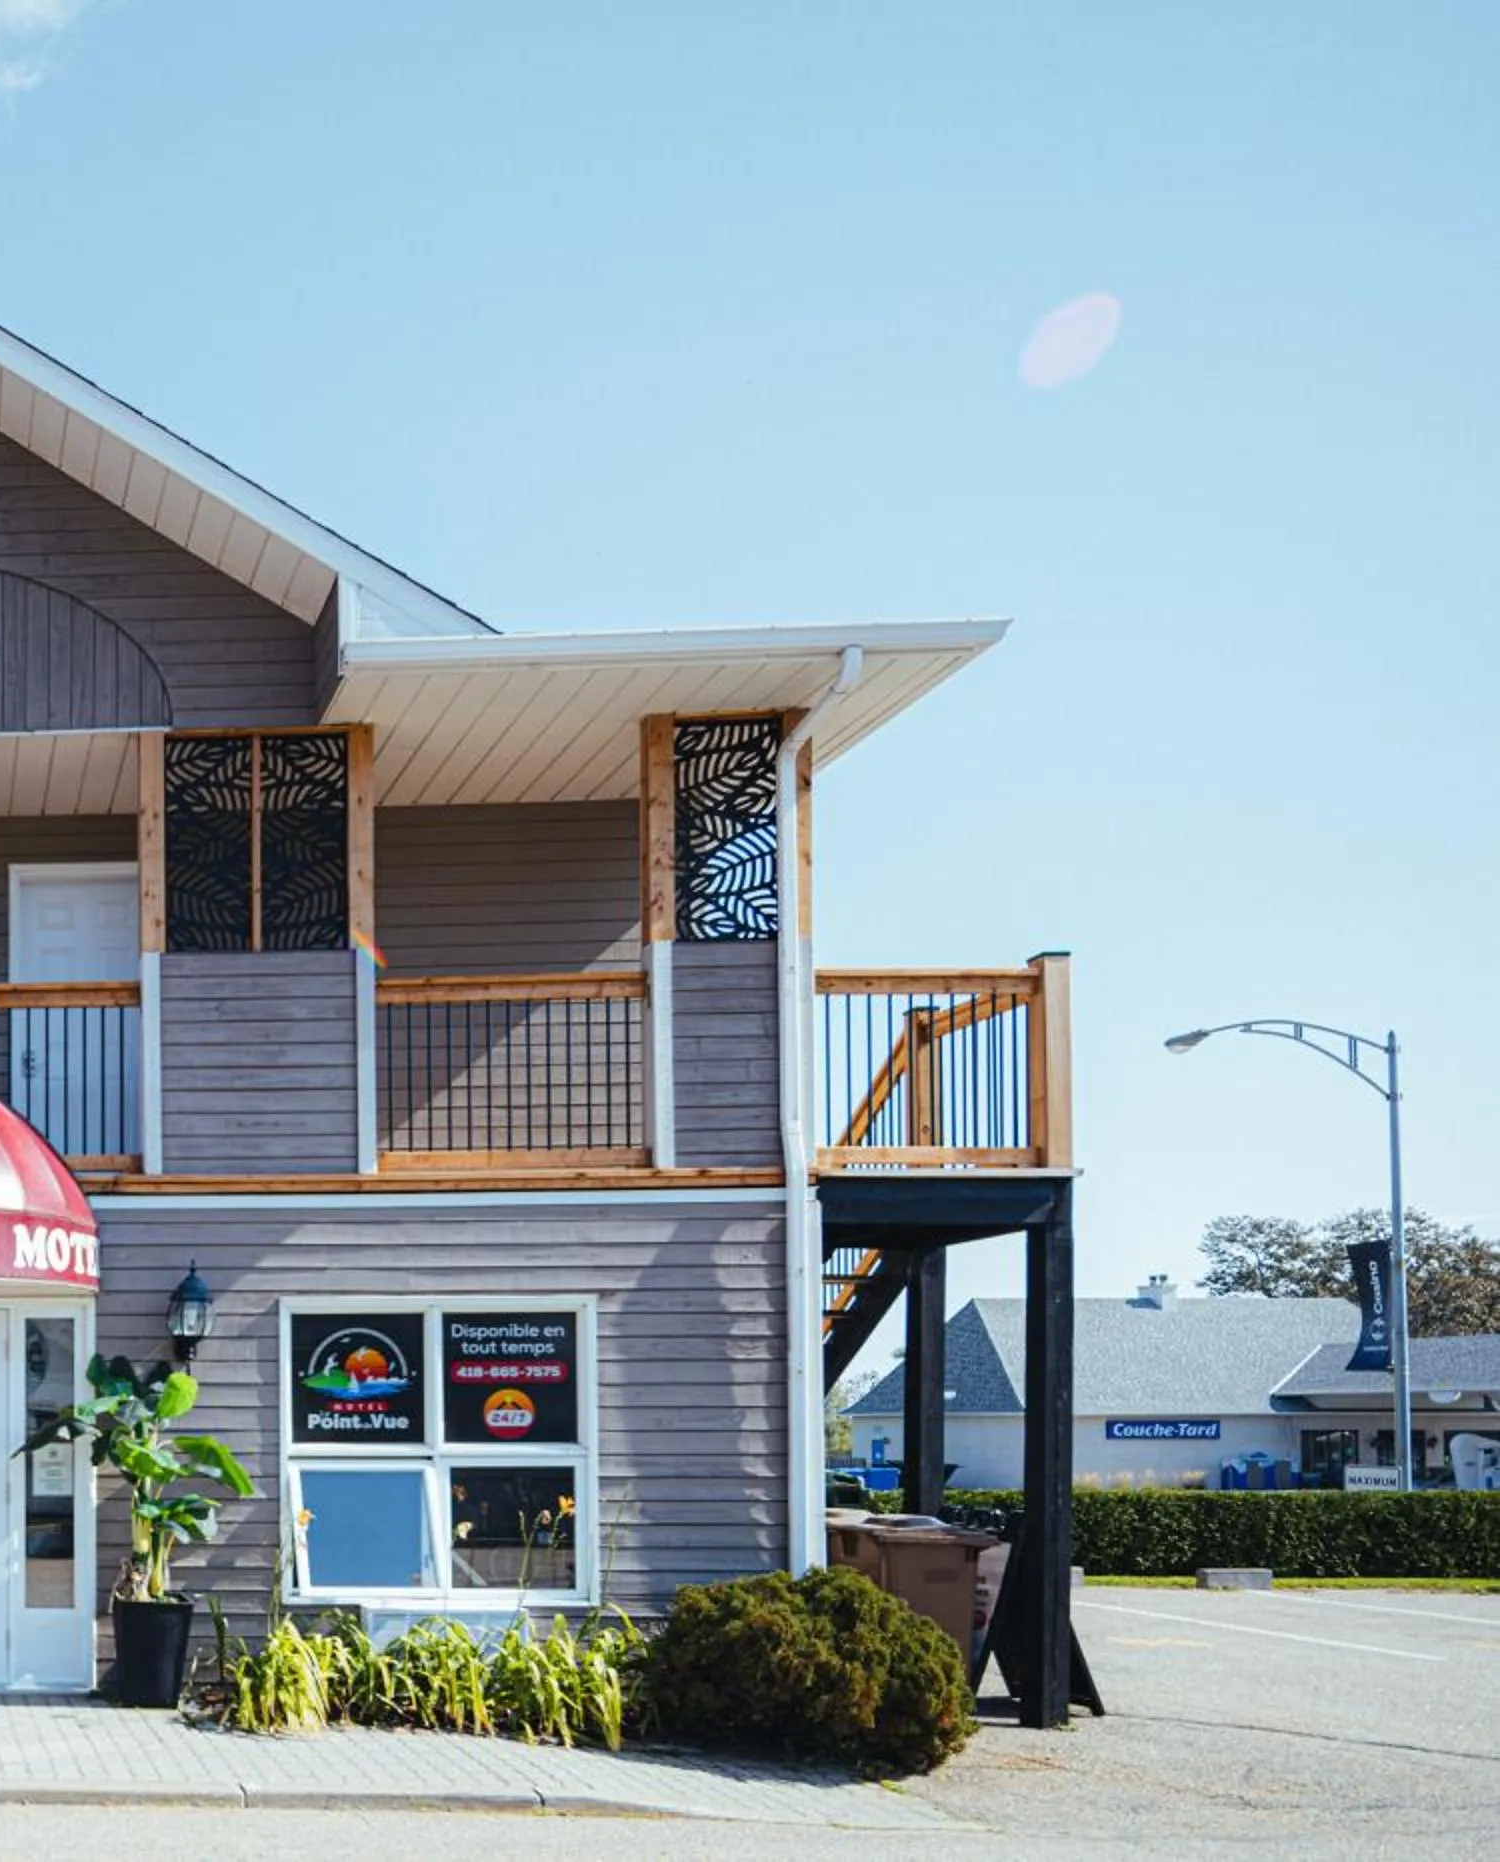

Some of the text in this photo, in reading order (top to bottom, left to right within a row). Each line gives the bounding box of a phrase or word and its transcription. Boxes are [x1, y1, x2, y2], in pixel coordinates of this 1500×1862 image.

[451, 1323, 565, 1341] Disponible en
[461, 1341, 555, 1357] tout temps
[307, 1412, 360, 1430] Point
[369, 1413, 410, 1430] Vue
[491, 1412, 526, 1423] 24/7
[1113, 1423, 1218, 1437] Couche-Tard
[1349, 1475, 1397, 1487] MAXIMUM
